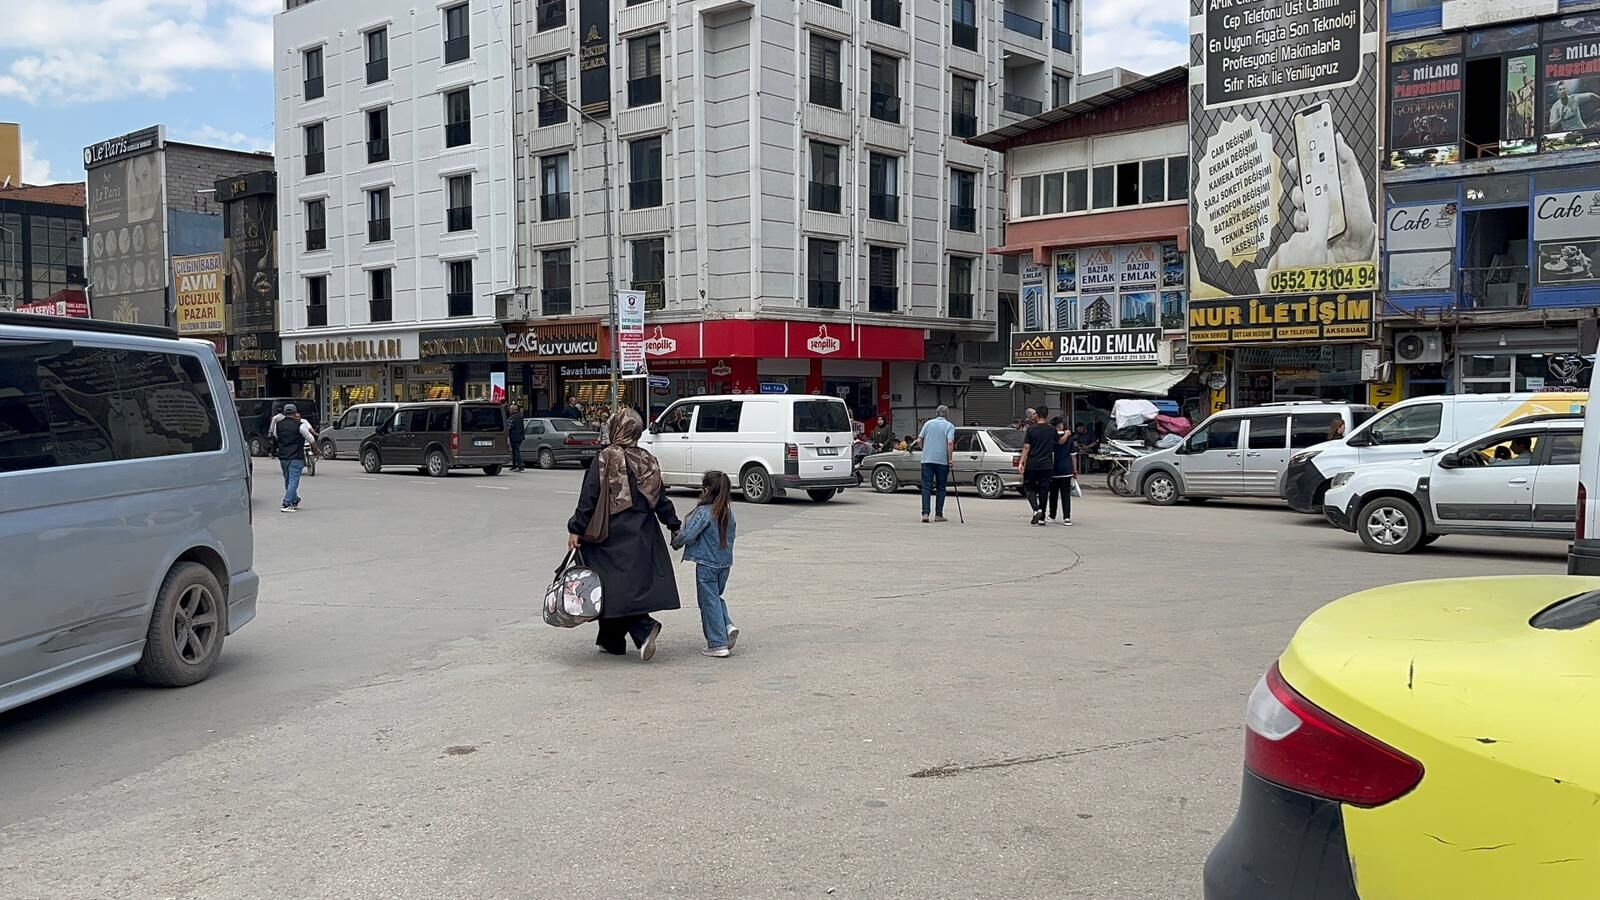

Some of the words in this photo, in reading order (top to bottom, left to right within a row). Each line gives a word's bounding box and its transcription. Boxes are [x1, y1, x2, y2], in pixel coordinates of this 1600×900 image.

[1223, 14, 1241, 30] Cep
[1243, 7, 1282, 25] Telefonu
[1285, 0, 1303, 13] Üst
[1209, 38, 1222, 53] En
[1223, 35, 1252, 53] Uygun
[1255, 27, 1286, 46] Fiyata
[1289, 23, 1309, 37] Son
[1312, 10, 1356, 32] Teknoloji
[1222, 47, 1278, 72] Profesyonel
[1280, 37, 1341, 58] Makinalarla
[1224, 78, 1244, 93] Sıfır
[1247, 71, 1268, 88] Risk
[1271, 67, 1283, 84] İle
[1284, 61, 1339, 83] Yeniliyoruz
[1413, 62, 1458, 81] MİLANO
[1394, 79, 1462, 98] Playstation
[92, 146, 103, 162] Le
[104, 138, 128, 158] Paris
[1211, 145, 1224, 160] CAM
[1225, 126, 1253, 152] DEĞİŞİMİ
[1208, 156, 1230, 177] EKRAN
[1230, 138, 1258, 164] DEĞİŞİMİ
[1208, 170, 1234, 192] KAMERA
[1235, 152, 1263, 177] DEĞİŞİMİ
[1203, 194, 1220, 211] ŞARJ
[1220, 178, 1243, 202] SOKETİ
[1244, 162, 1272, 188] DEĞİŞİMİ
[1209, 198, 1242, 222] MİKROFON
[1242, 179, 1270, 205] DEĞİŞİMİ
[1538, 194, 1584, 220] Cafe
[1213, 213, 1241, 235] BATARYA
[1242, 195, 1270, 220] DEĞİŞİMİ
[1390, 208, 1432, 232] Cafe
[1221, 225, 1245, 246] TEKNİK
[1245, 213, 1269, 234] SERVİS
[1231, 232, 1265, 256] AKSESUAR
[200, 258, 220, 271] BABA
[1121, 270, 1157, 282] EMLAK
[180, 273, 216, 292] AVM
[1082, 273, 1115, 284] EMLAK
[1271, 271, 1306, 291] 0552
[1358, 266, 1376, 286] 94
[35, 302, 55, 315] SERVİS
[178, 292, 221, 306] UCUZLUK
[1190, 307, 1242, 328] NUR
[1248, 294, 1370, 324] İLETİŞİM
[184, 306, 216, 320] PAZARI
[506, 328, 538, 353] ÇAĞ
[1191, 331, 1210, 339] TEKNİK
[1243, 330, 1252, 338] CAM
[1278, 328, 1289, 336] CEP
[1290, 327, 1318, 336] TELEFONU
[1326, 326, 1366, 334] AKSESUAR
[294, 337, 402, 362] İSMAİLOĞULLARI
[538, 342, 598, 355] KUYUMCU
[645, 340, 672, 351] şenpiliç
[810, 339, 836, 350] şenpiliç
[1060, 332, 1101, 354] BAZİD
[1106, 332, 1156, 353] EMLAK
[560, 366, 583, 378] Savaş
